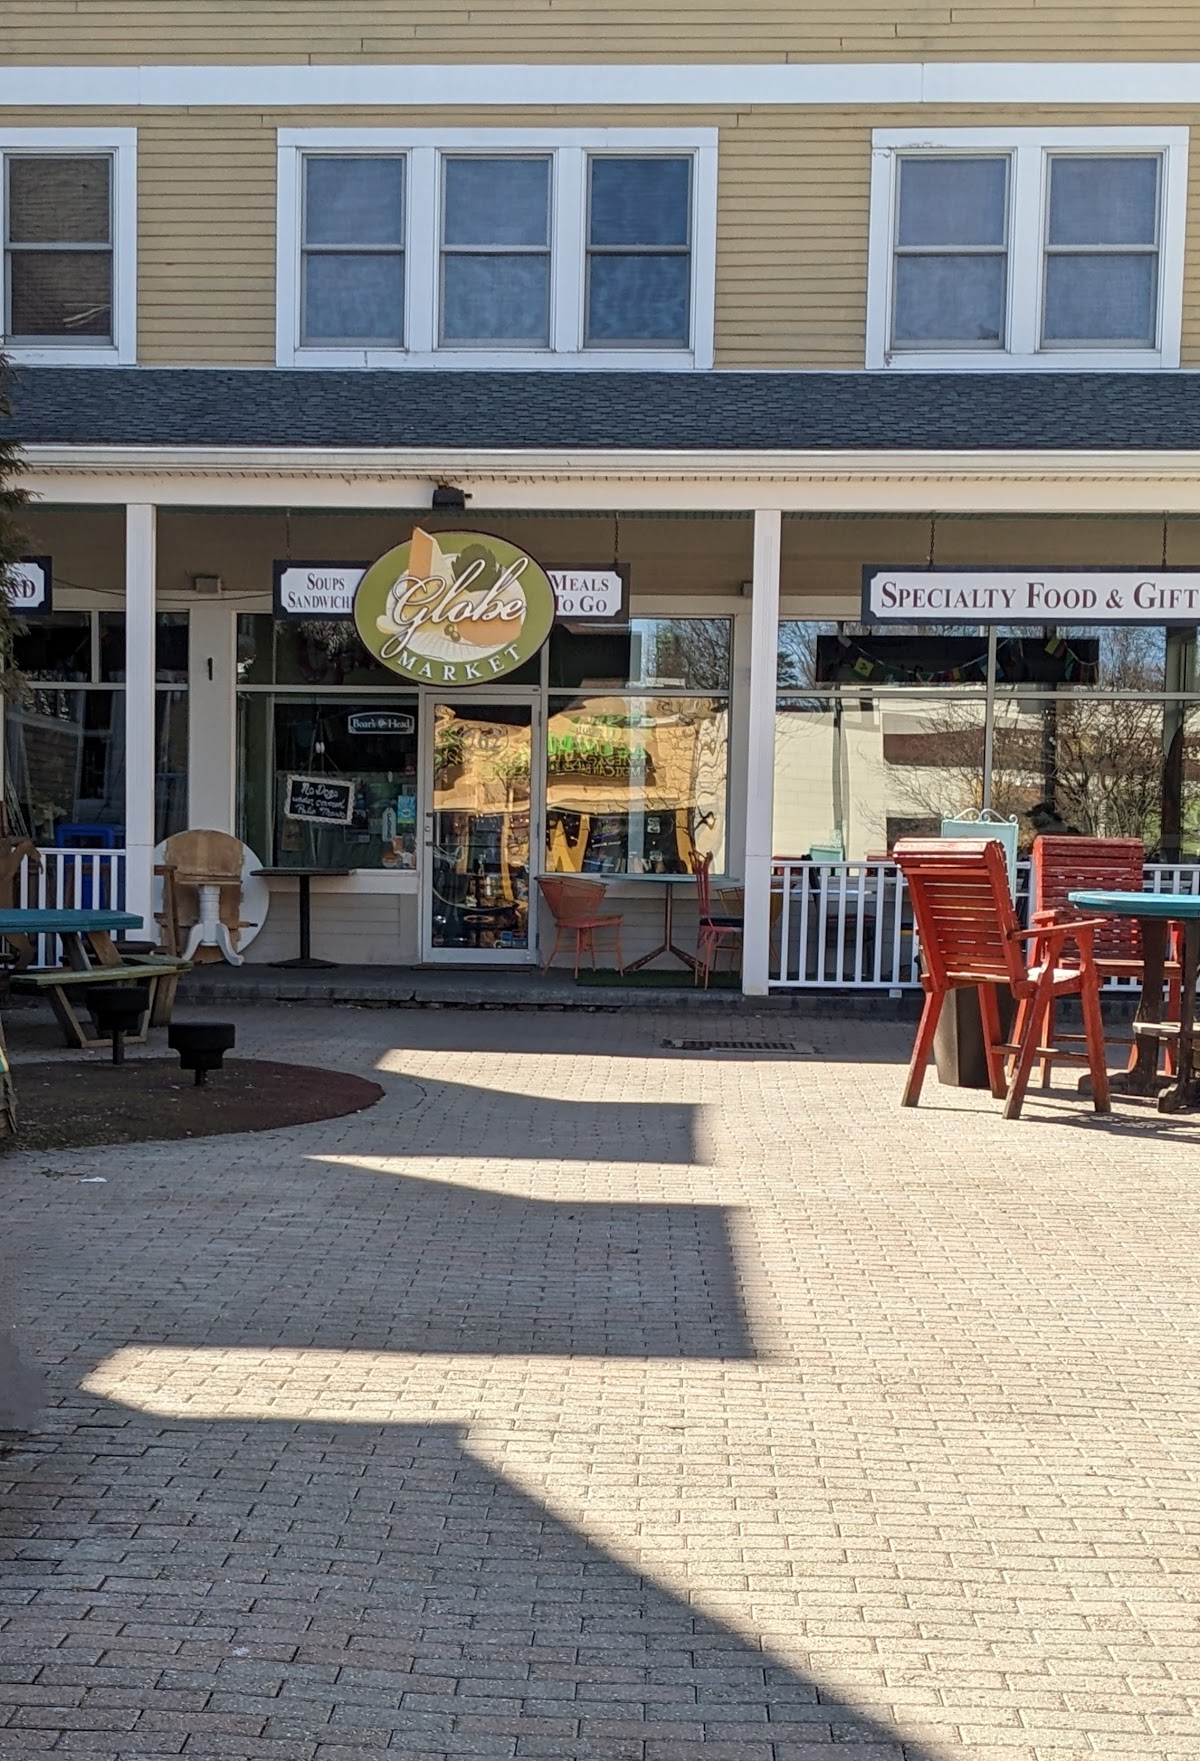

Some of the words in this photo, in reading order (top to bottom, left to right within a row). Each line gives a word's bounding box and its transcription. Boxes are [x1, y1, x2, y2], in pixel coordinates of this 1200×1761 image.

[306, 572, 345, 591] SOUPS
[551, 574, 609, 592] MEALS
[287, 591, 354, 609] SANDWICH
[579, 595, 607, 613] GO
[881, 581, 1016, 609] SPECIALTY
[1025, 581, 1097, 609] FOOD
[1105, 588, 1125, 609] &
[1133, 581, 1199, 609] GIFT
[380, 556, 528, 659] Globe
[397, 644, 521, 681] MARKET
[388, 718, 410, 728] Head
[301, 782, 315, 796] No
